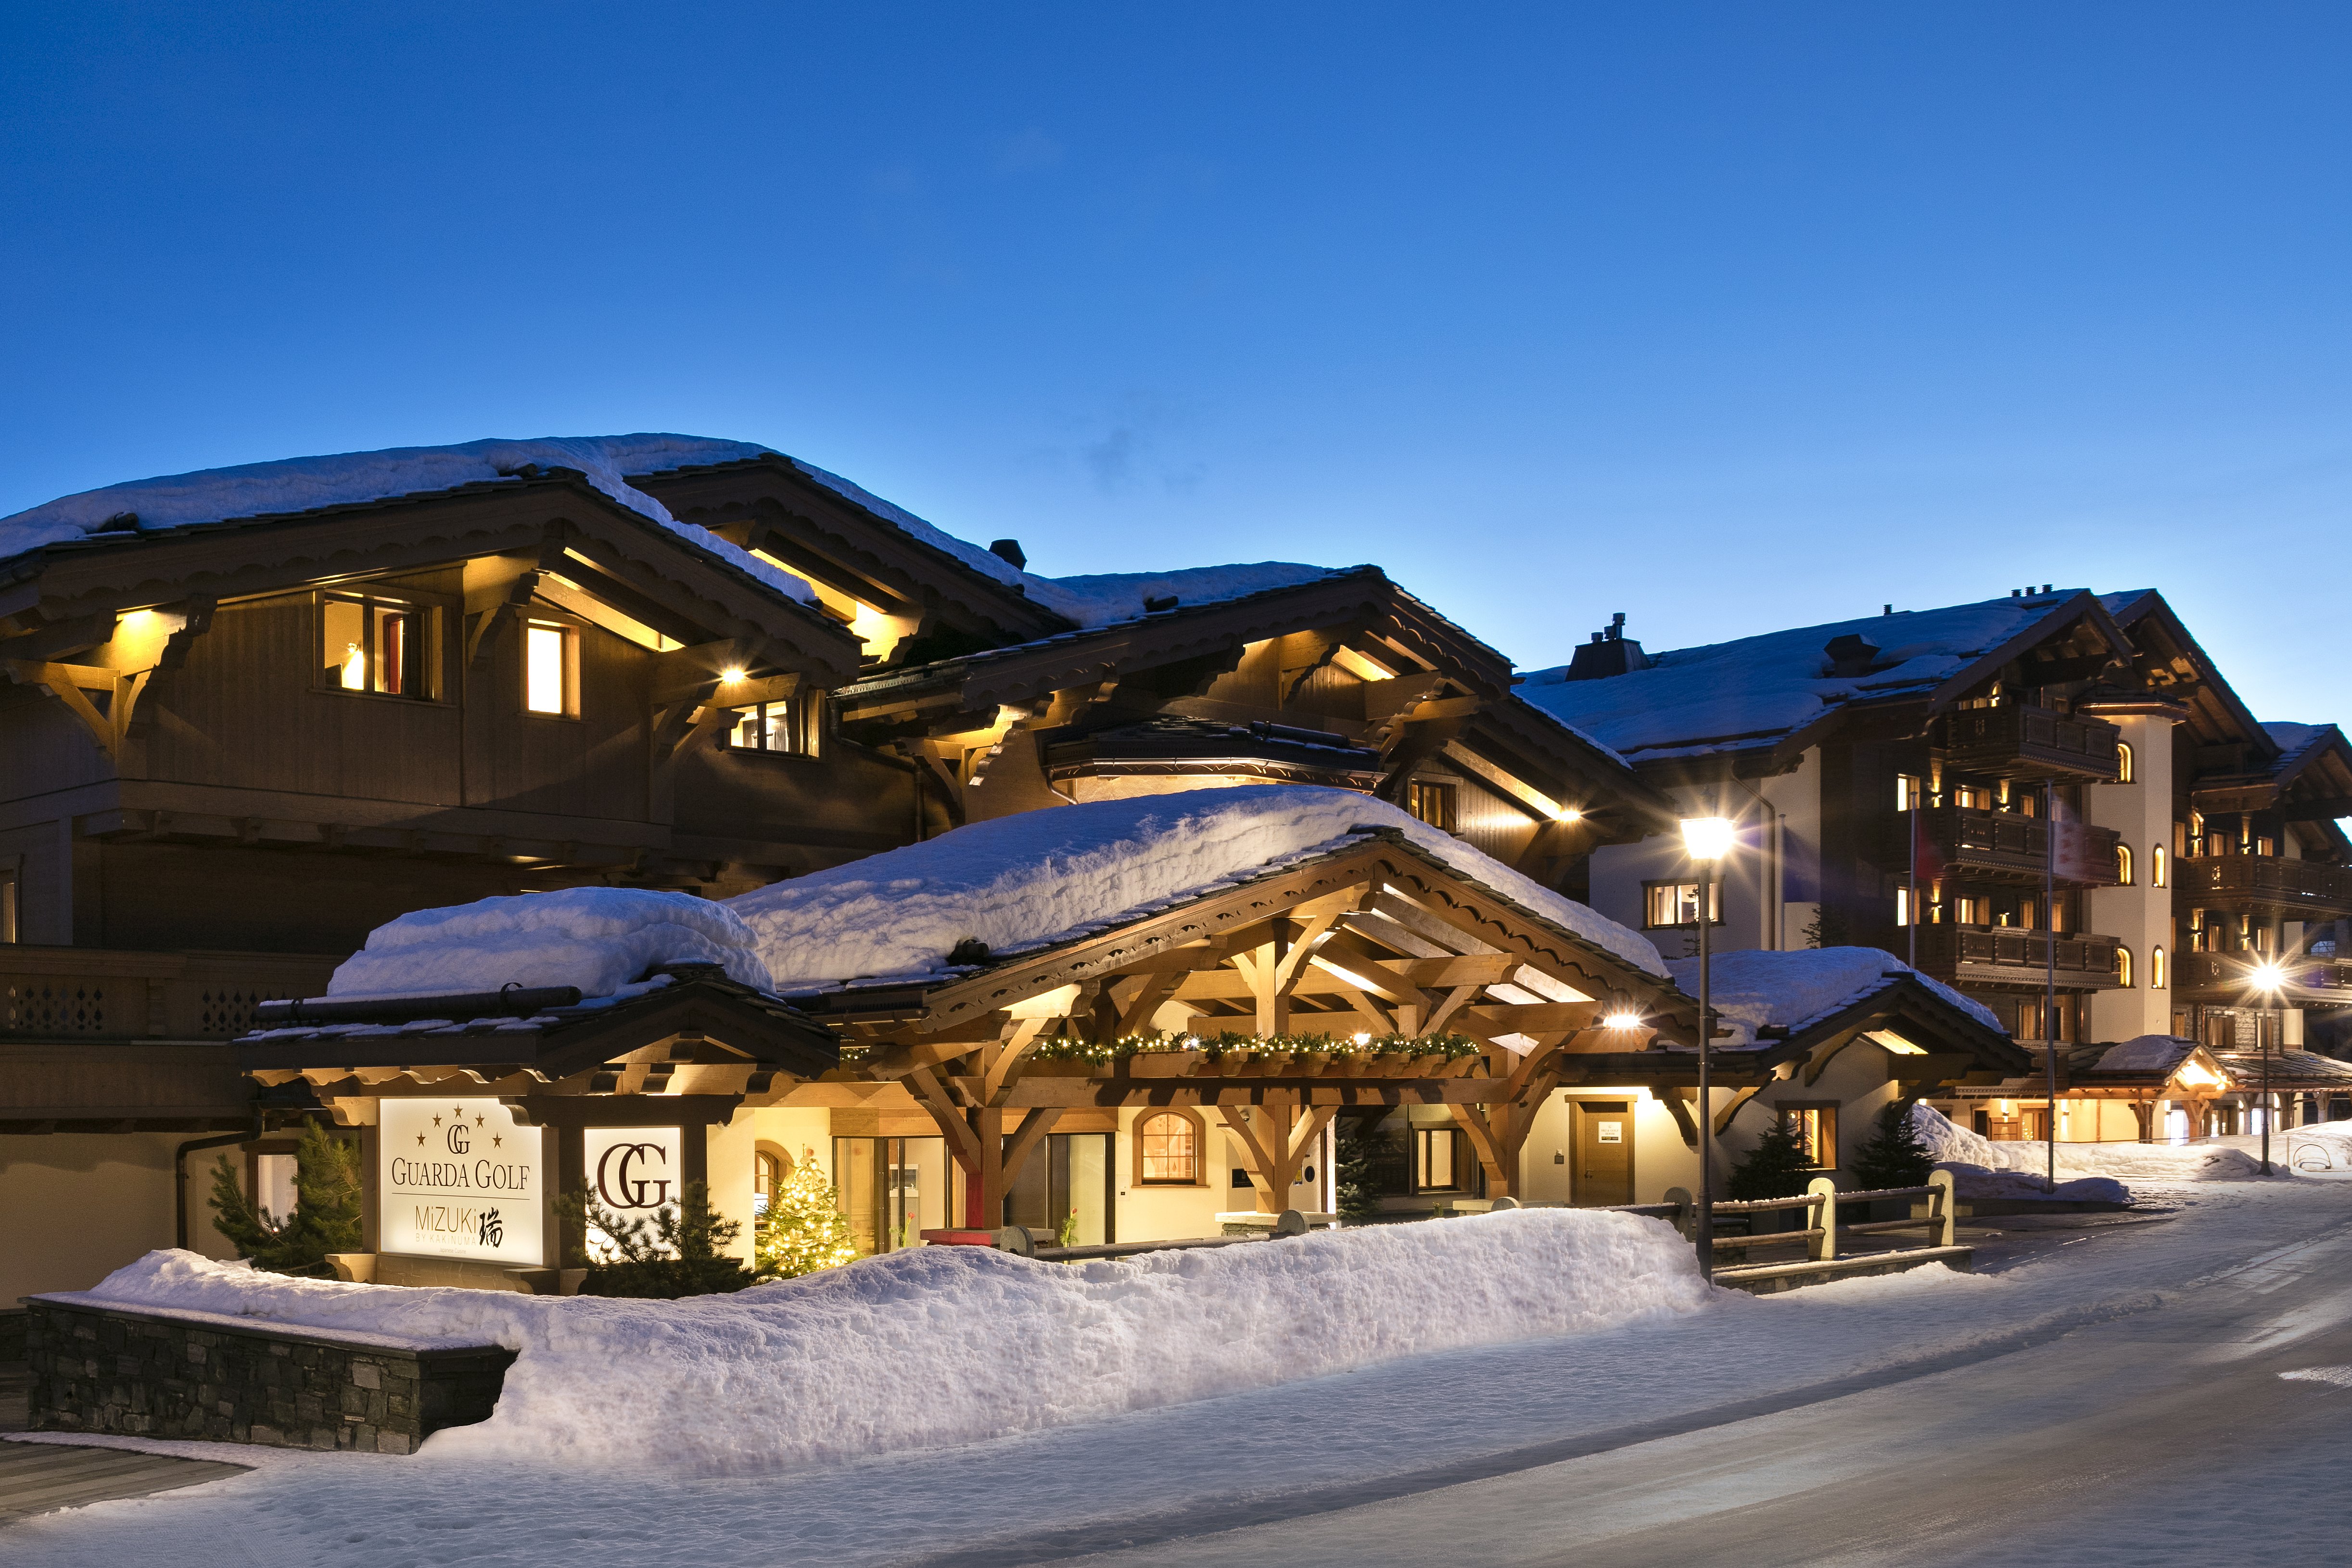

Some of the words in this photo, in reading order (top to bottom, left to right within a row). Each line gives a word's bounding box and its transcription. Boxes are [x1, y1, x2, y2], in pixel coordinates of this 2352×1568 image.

[392, 1157, 470, 1187] GUARDA
[475, 1160, 530, 1190] GOLF
[416, 1233, 426, 1242] BY
